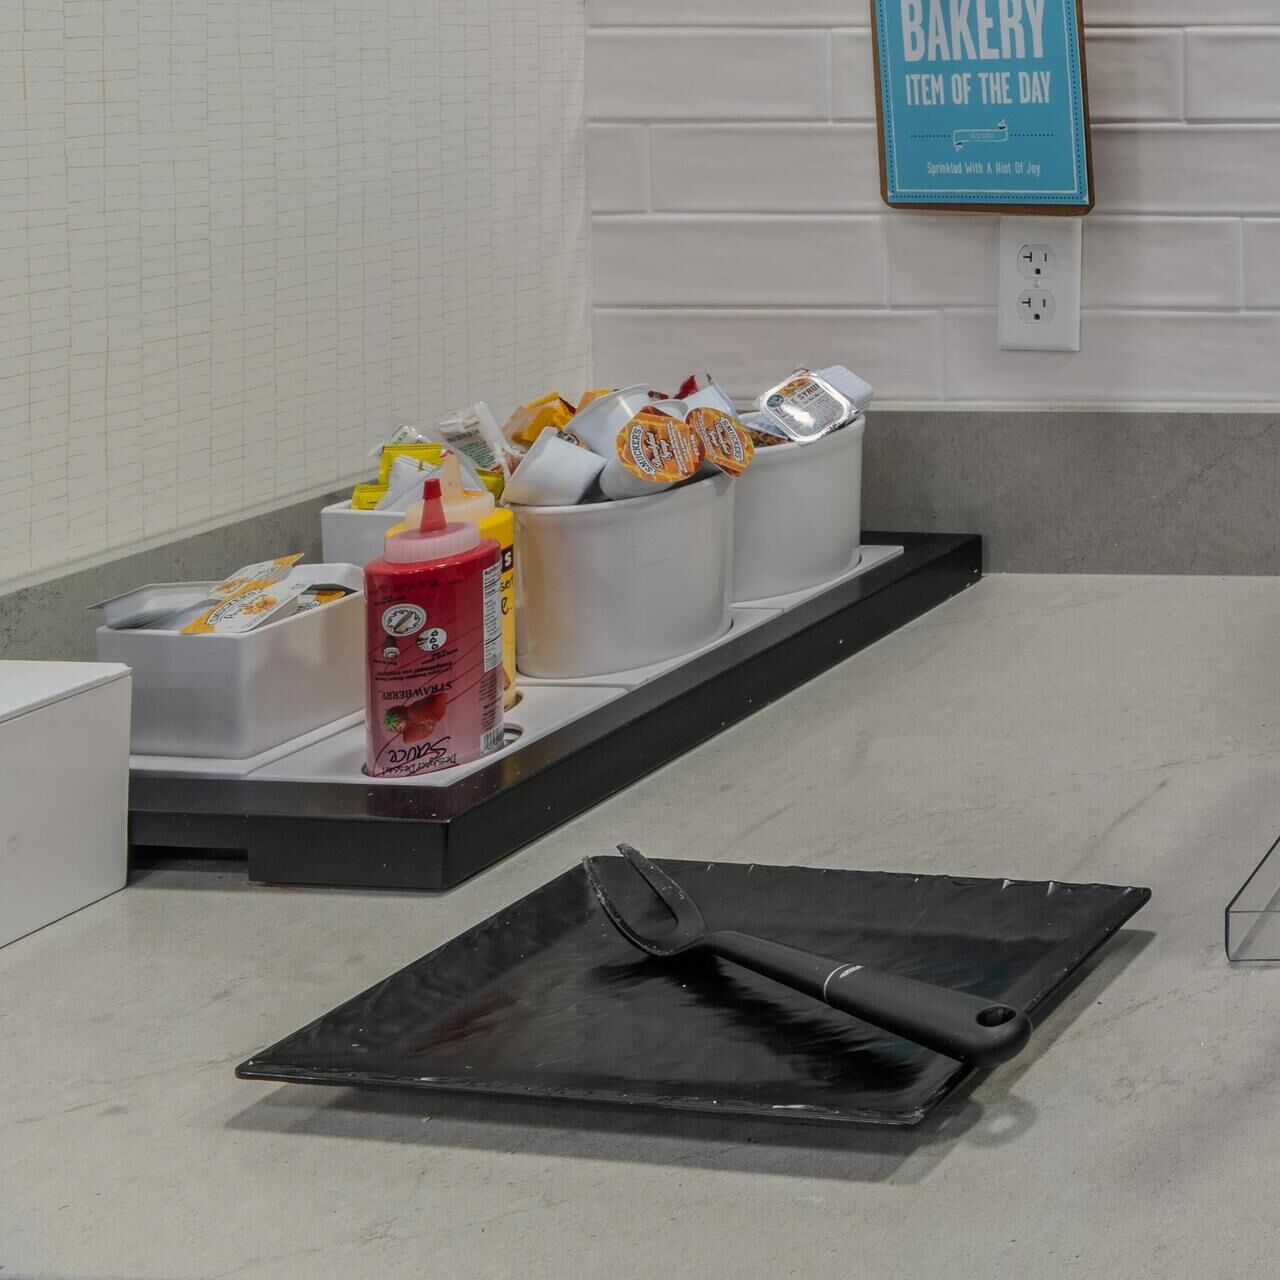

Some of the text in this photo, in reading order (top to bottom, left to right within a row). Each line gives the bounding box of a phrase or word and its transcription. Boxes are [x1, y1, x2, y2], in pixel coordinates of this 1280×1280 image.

[905, 71, 1051, 106] ITEM OF THE DAY
[927, 162, 962, 176] Sprinkled
[966, 162, 983, 174] With
[995, 162, 1011, 174] Hint
[630, 424, 655, 475] SMUCKER'S
[380, 681, 452, 701] STRAWBERRY
